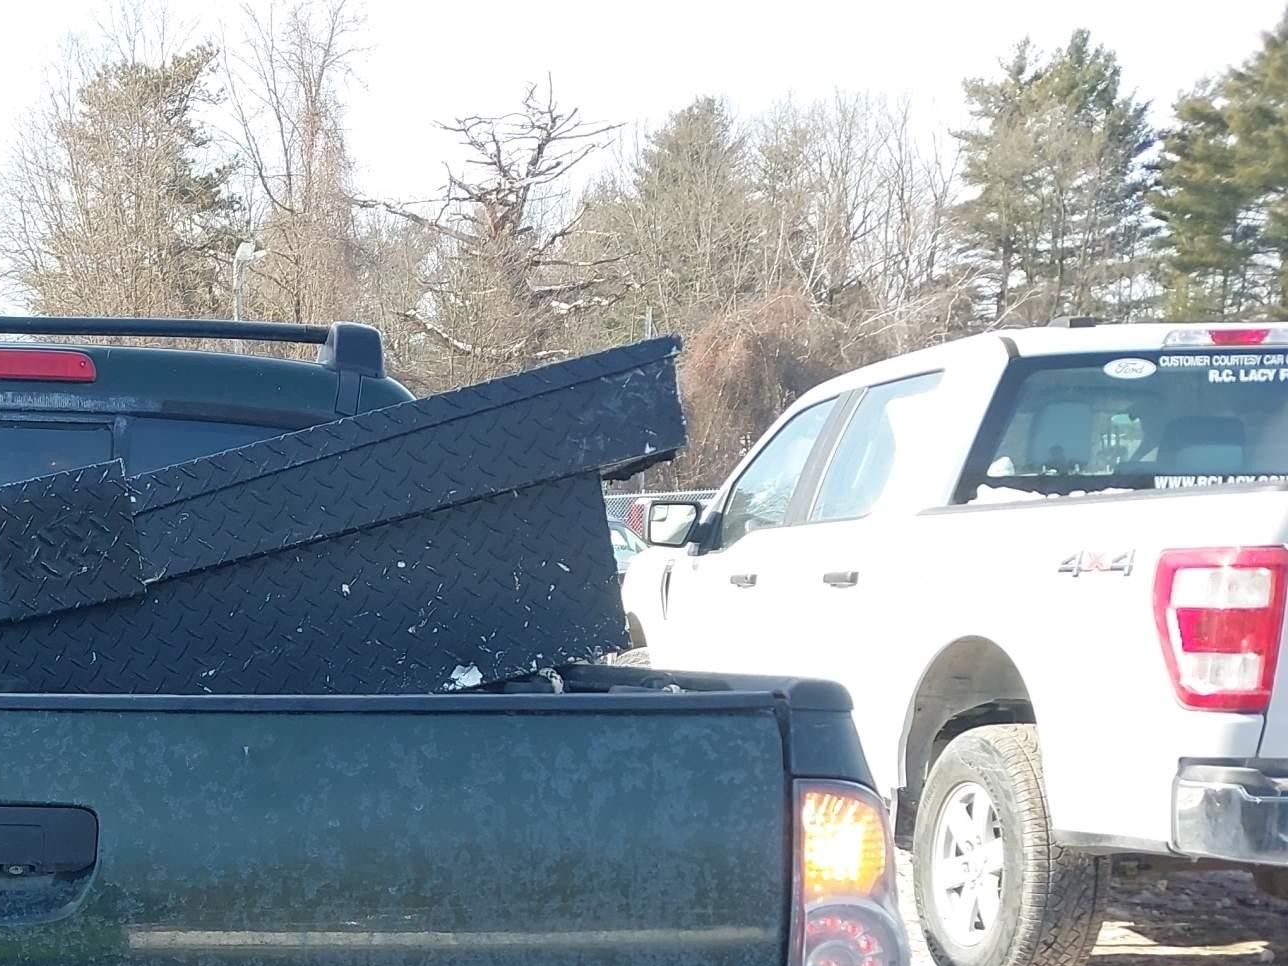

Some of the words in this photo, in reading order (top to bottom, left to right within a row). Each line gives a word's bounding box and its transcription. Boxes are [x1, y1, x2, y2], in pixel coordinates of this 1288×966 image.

[1159, 355, 1210, 367] CUSTOMER
[1212, 354, 1262, 366] COURTESY
[1263, 354, 1285, 365] CAR
[1114, 361, 1145, 376] Ford
[1208, 369, 1236, 382] R.C.
[1239, 368, 1277, 382] LACY
